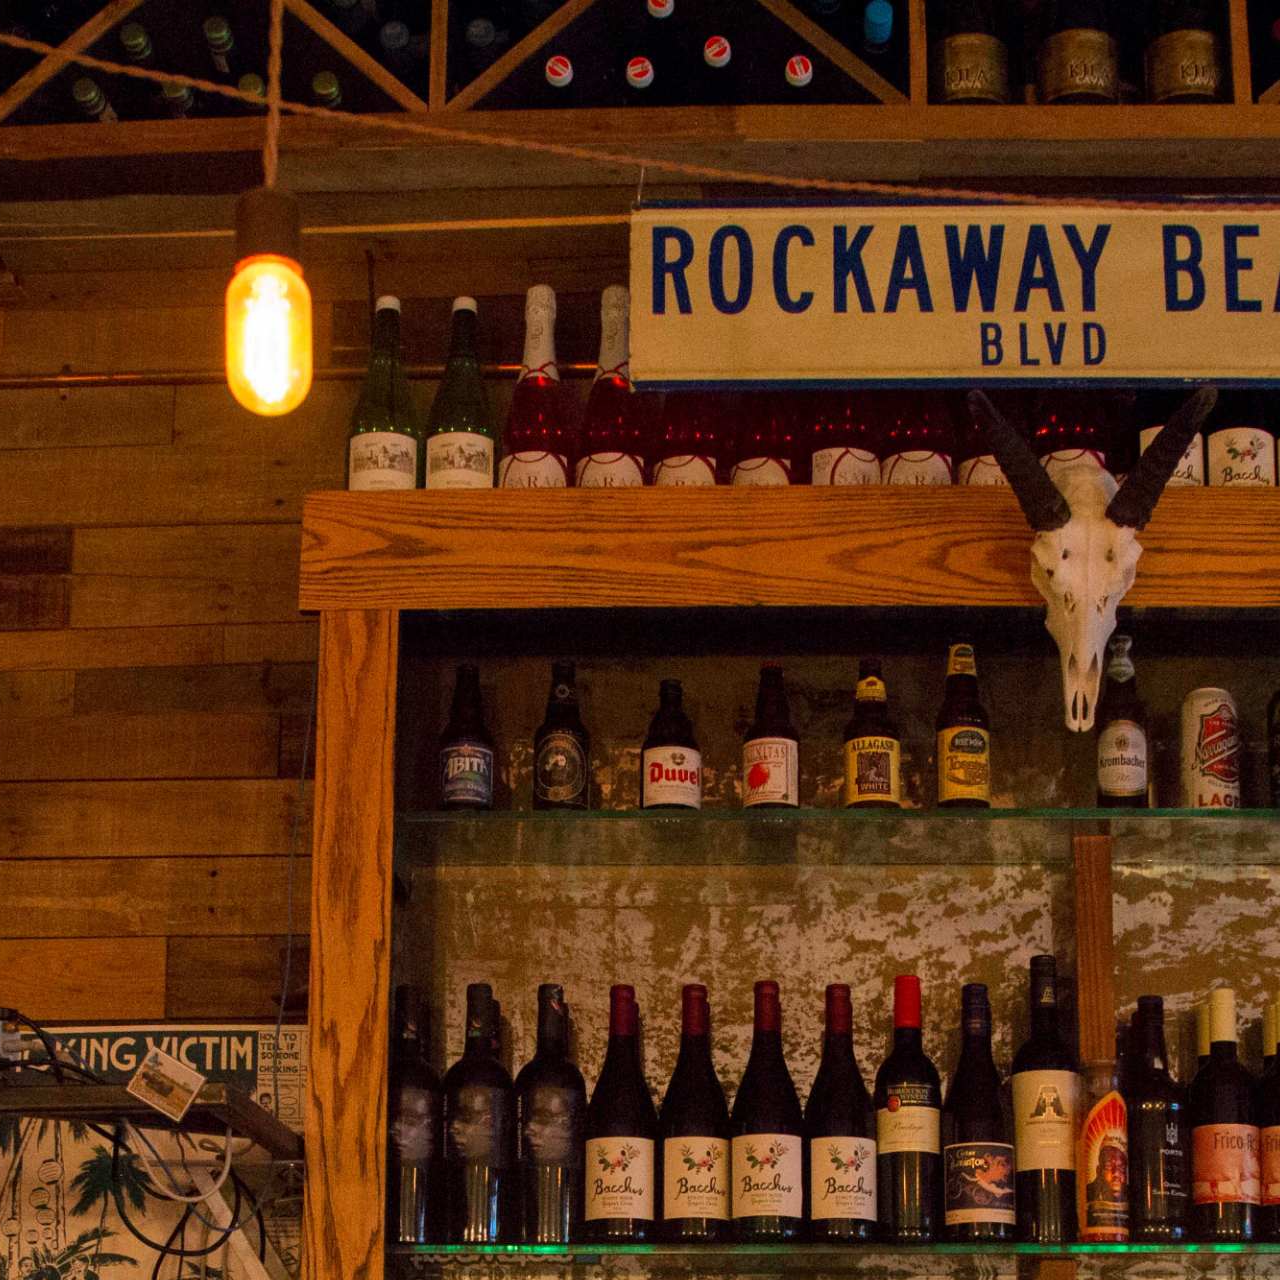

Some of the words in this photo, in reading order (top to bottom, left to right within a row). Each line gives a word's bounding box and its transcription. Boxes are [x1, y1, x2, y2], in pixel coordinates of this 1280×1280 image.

[653, 224, 1111, 314] ROCKAWAY
[980, 322, 1106, 366] BLVD
[649, 762, 700, 785] Duvel
[1213, 1132, 1244, 1151] Frico
[592, 1177, 644, 1201] Bacchus
[739, 1173, 793, 1199] Bacchus
